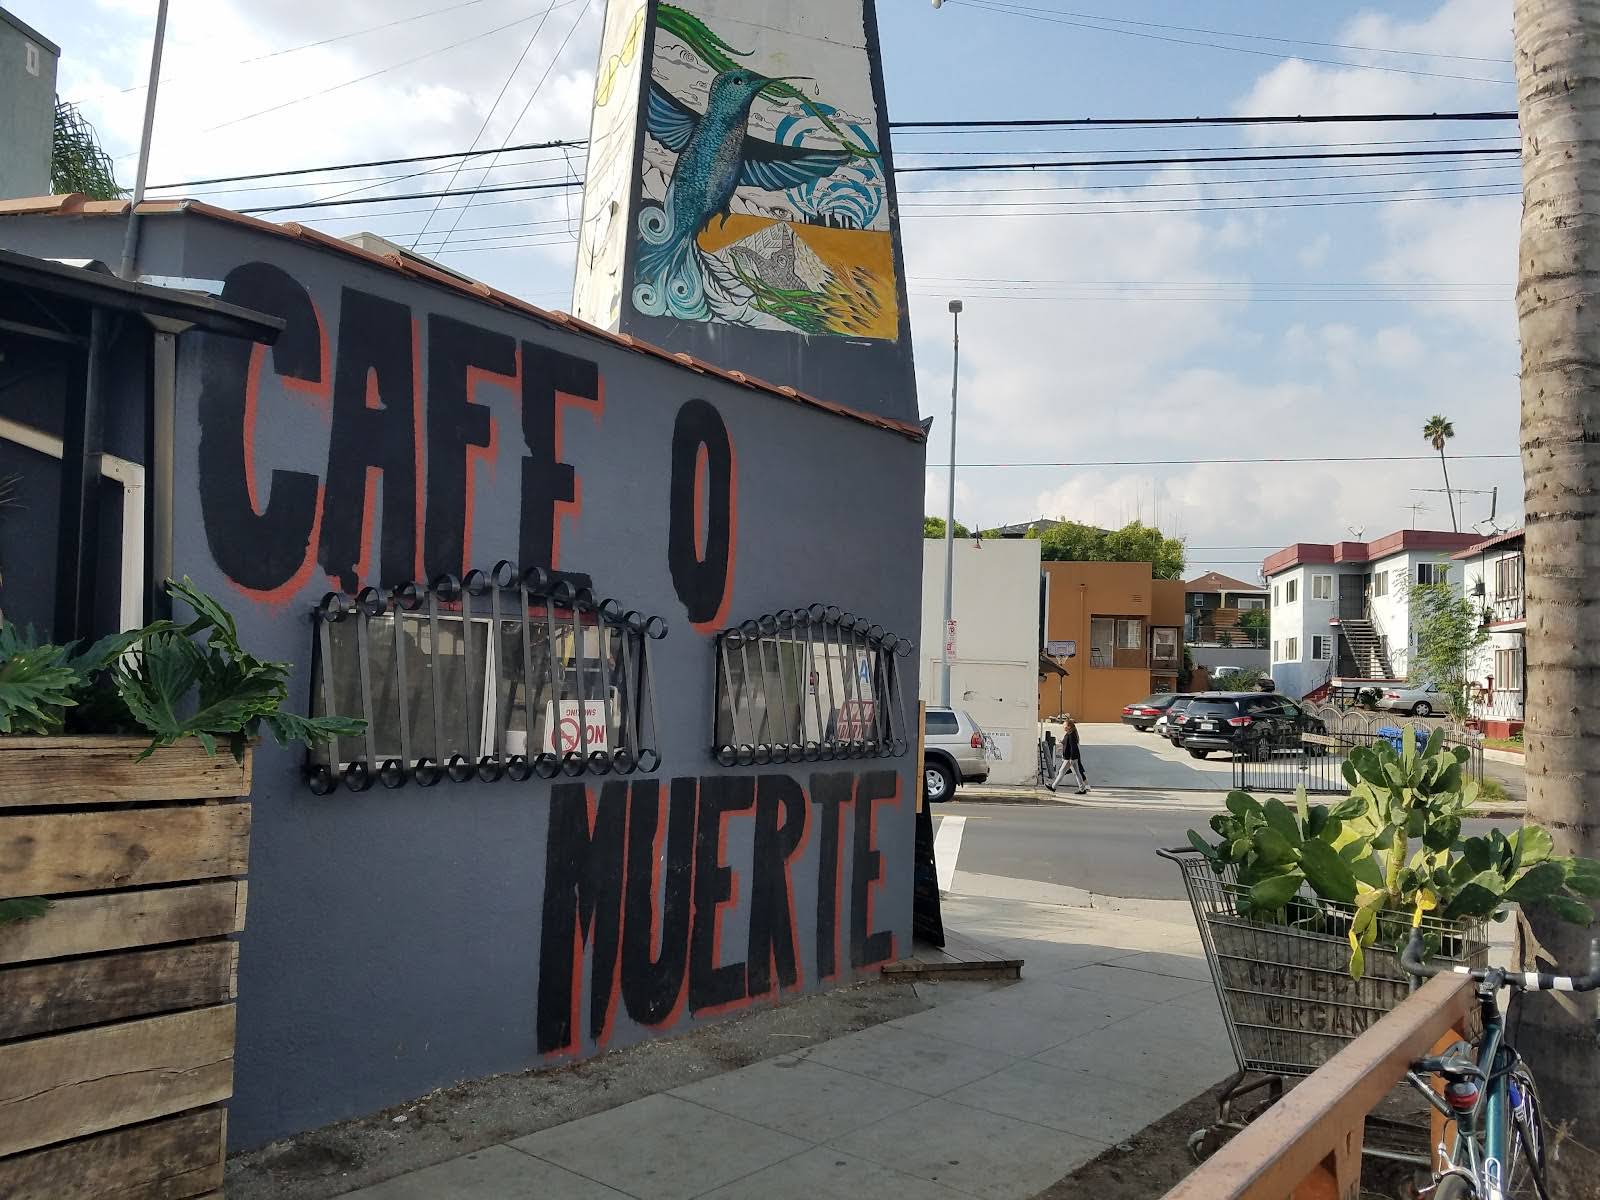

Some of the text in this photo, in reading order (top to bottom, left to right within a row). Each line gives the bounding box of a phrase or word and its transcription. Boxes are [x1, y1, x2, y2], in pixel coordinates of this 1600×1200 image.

[199, 261, 734, 629] CAFE O
[566, 708, 597, 717] SMING
[584, 724, 605, 745] NO
[536, 769, 899, 1057] MUERTE
